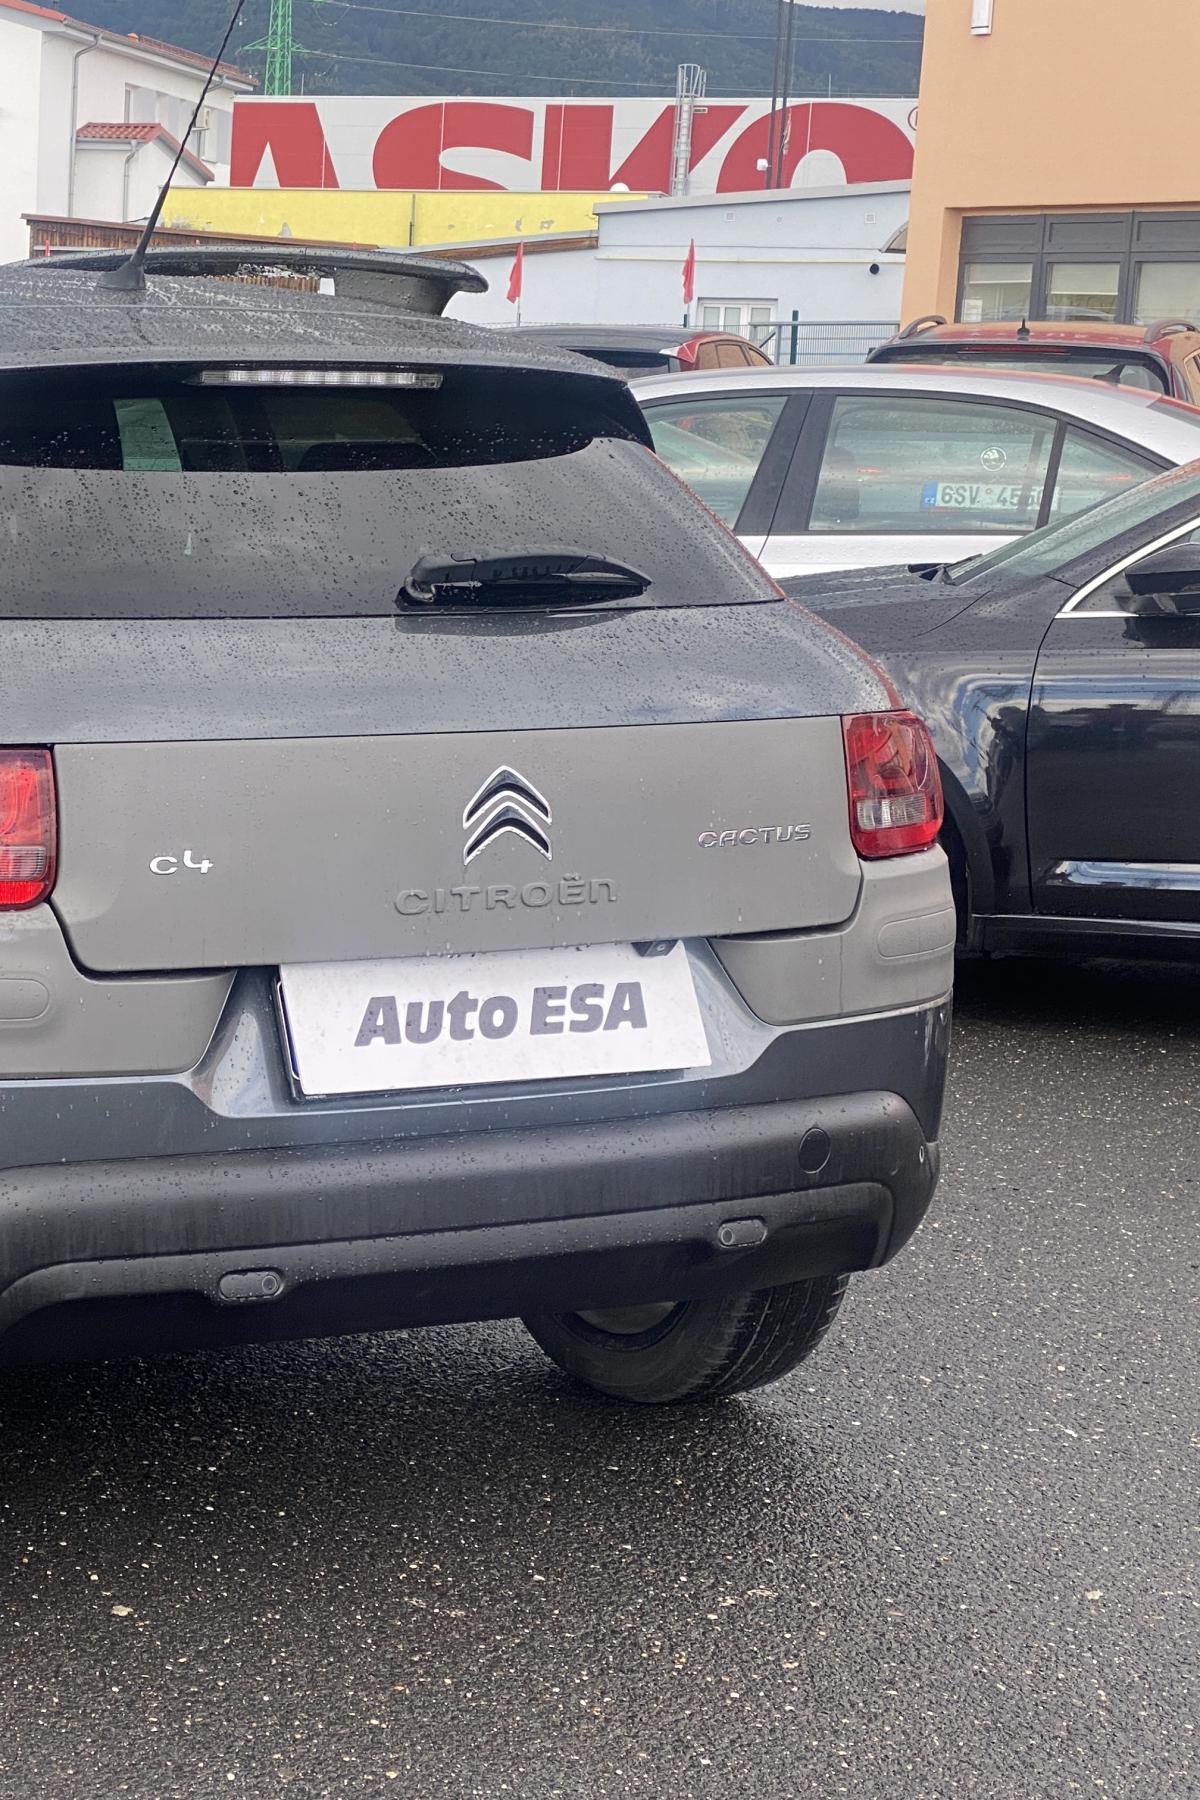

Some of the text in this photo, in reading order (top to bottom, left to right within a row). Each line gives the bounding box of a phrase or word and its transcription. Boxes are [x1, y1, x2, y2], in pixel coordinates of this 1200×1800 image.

[230, 102, 915, 194] ASKO
[941, 485, 980, 505] 6SV
[698, 823, 812, 848] CACTUS
[354, 982, 648, 1047] Auto ESA
